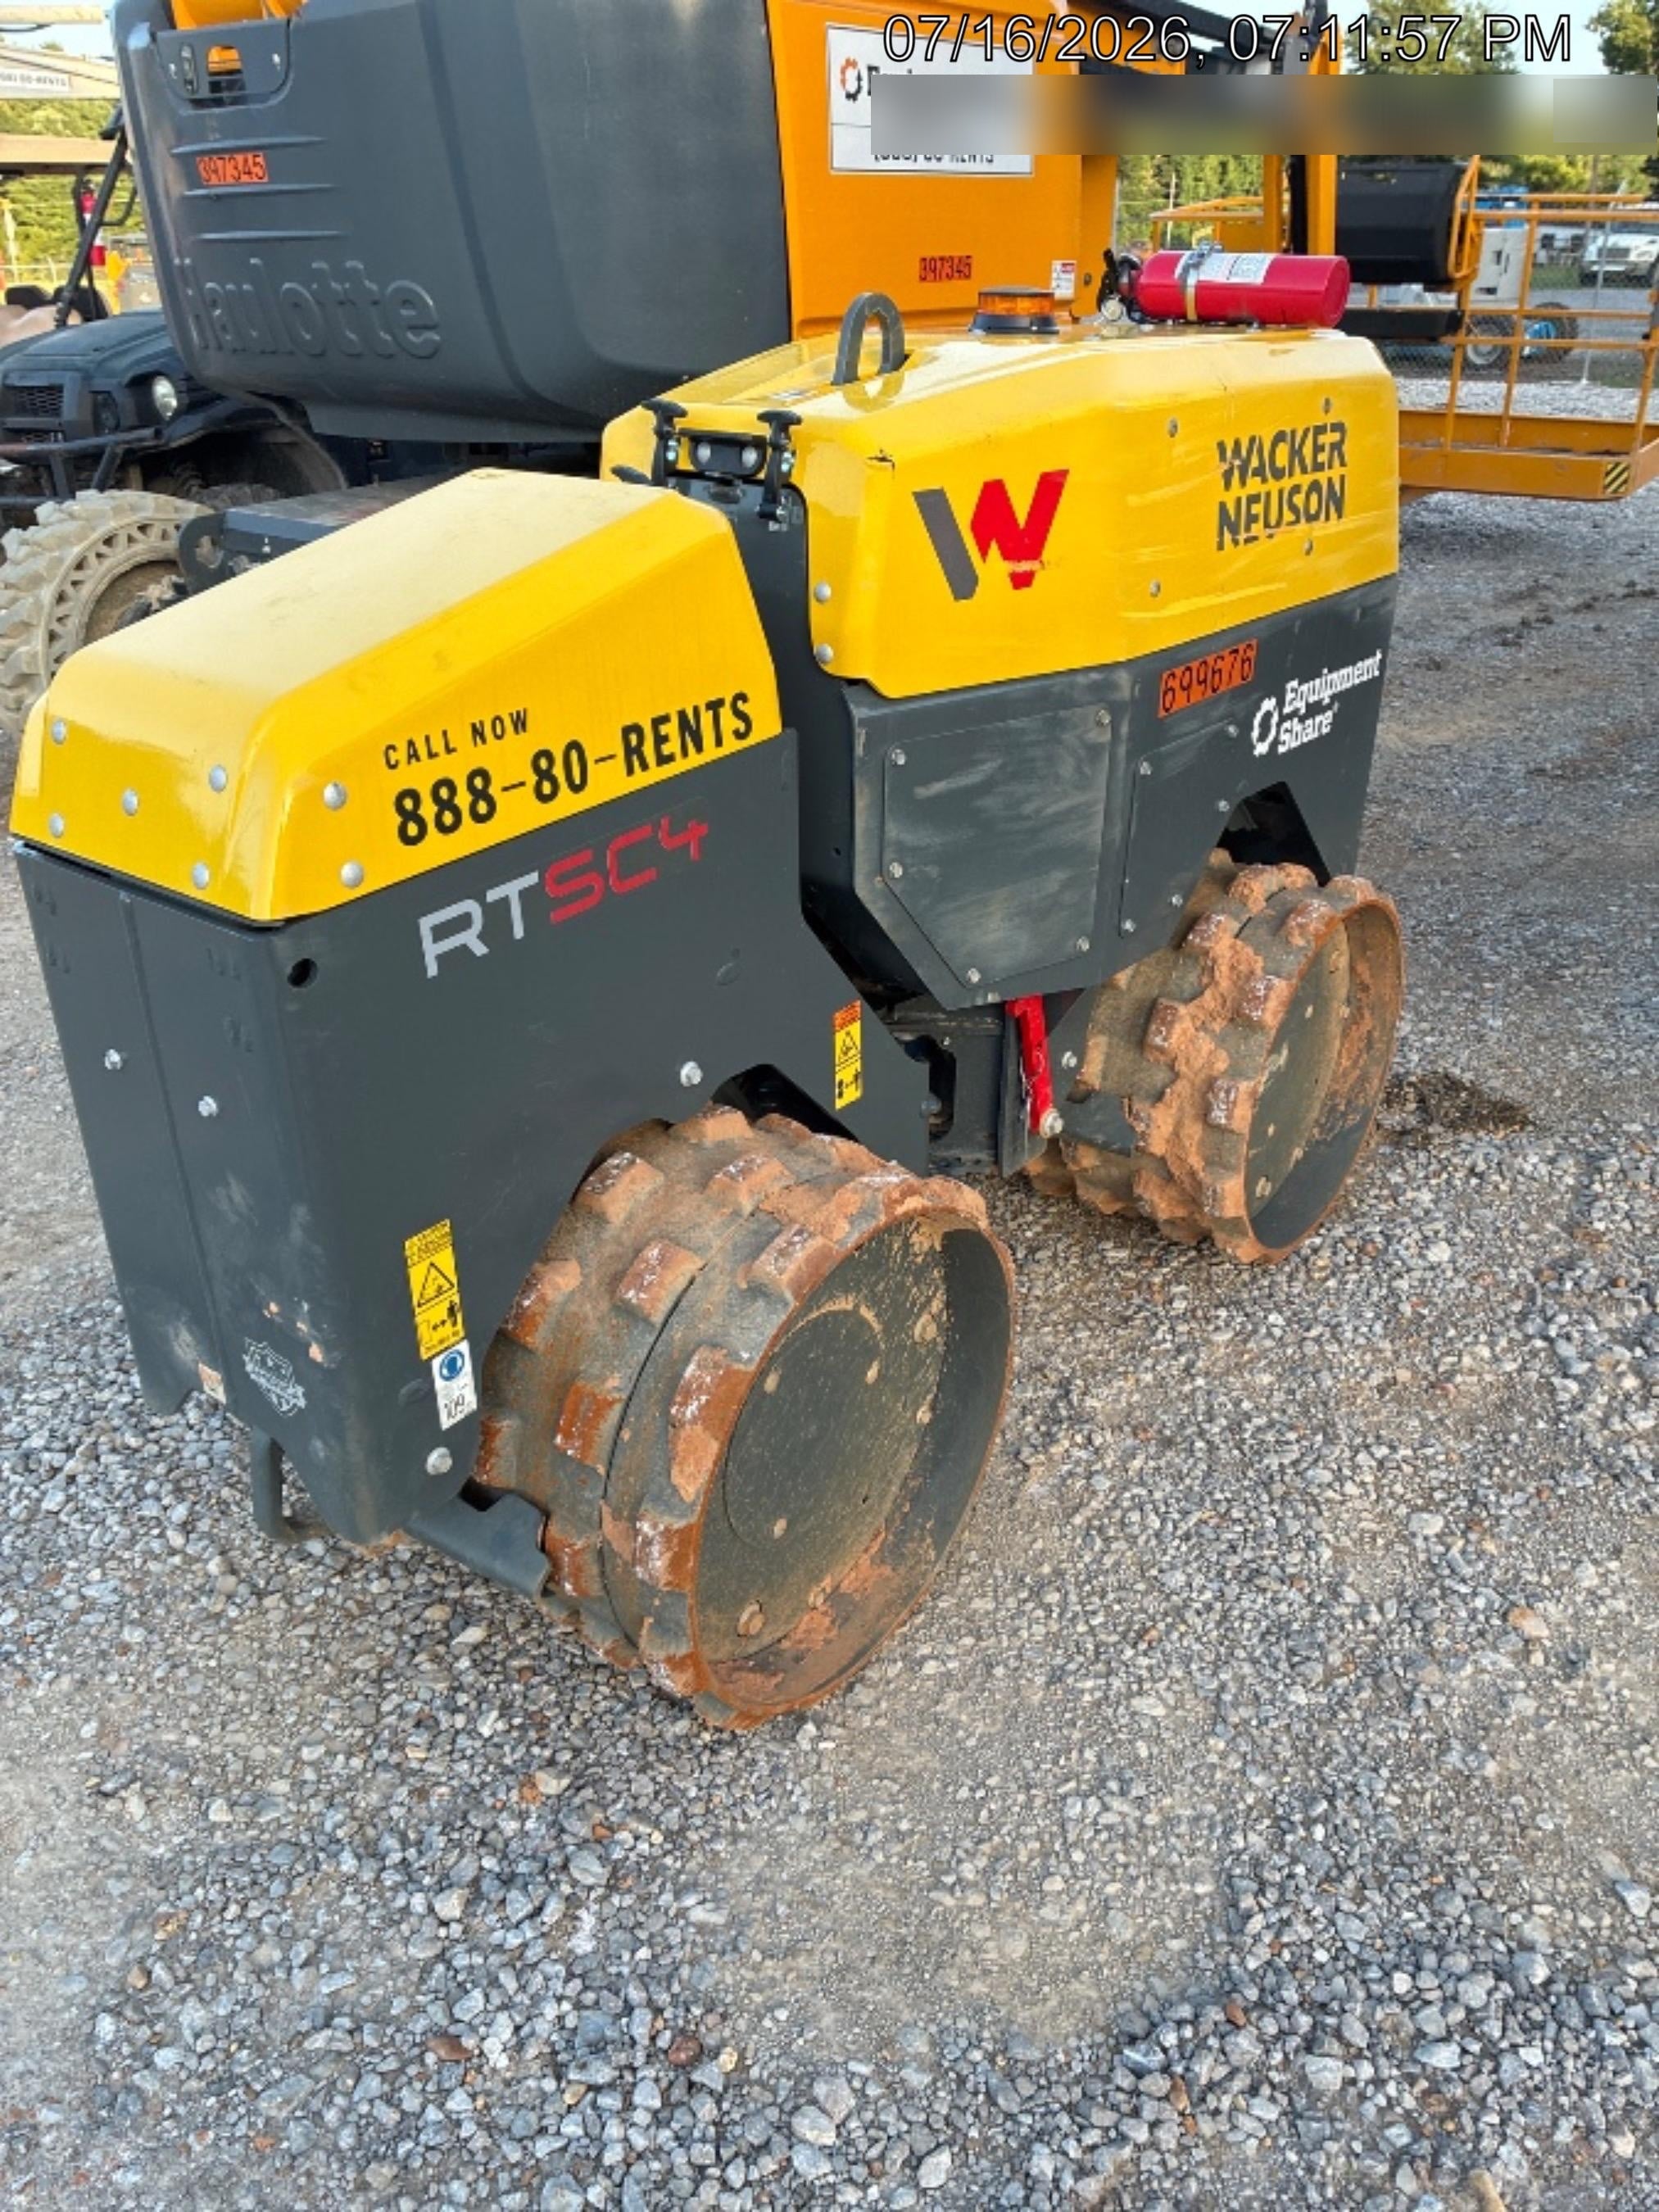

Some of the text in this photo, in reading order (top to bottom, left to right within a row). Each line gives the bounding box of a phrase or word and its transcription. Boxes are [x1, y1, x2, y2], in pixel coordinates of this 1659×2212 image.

[197, 153, 266, 183] 397345
[918, 255, 972, 282] 397345
[1216, 420, 1348, 492] WACKER
[1216, 474, 1346, 551] NEUSON
[1161, 643, 1254, 714] 699676
[1282, 648, 1382, 715] Equipment
[383, 708, 528, 770] CALL NOW
[1277, 709, 1334, 755] Share
[394, 691, 754, 847] 888-80-RENTS
[419, 814, 709, 980] RTSC4
